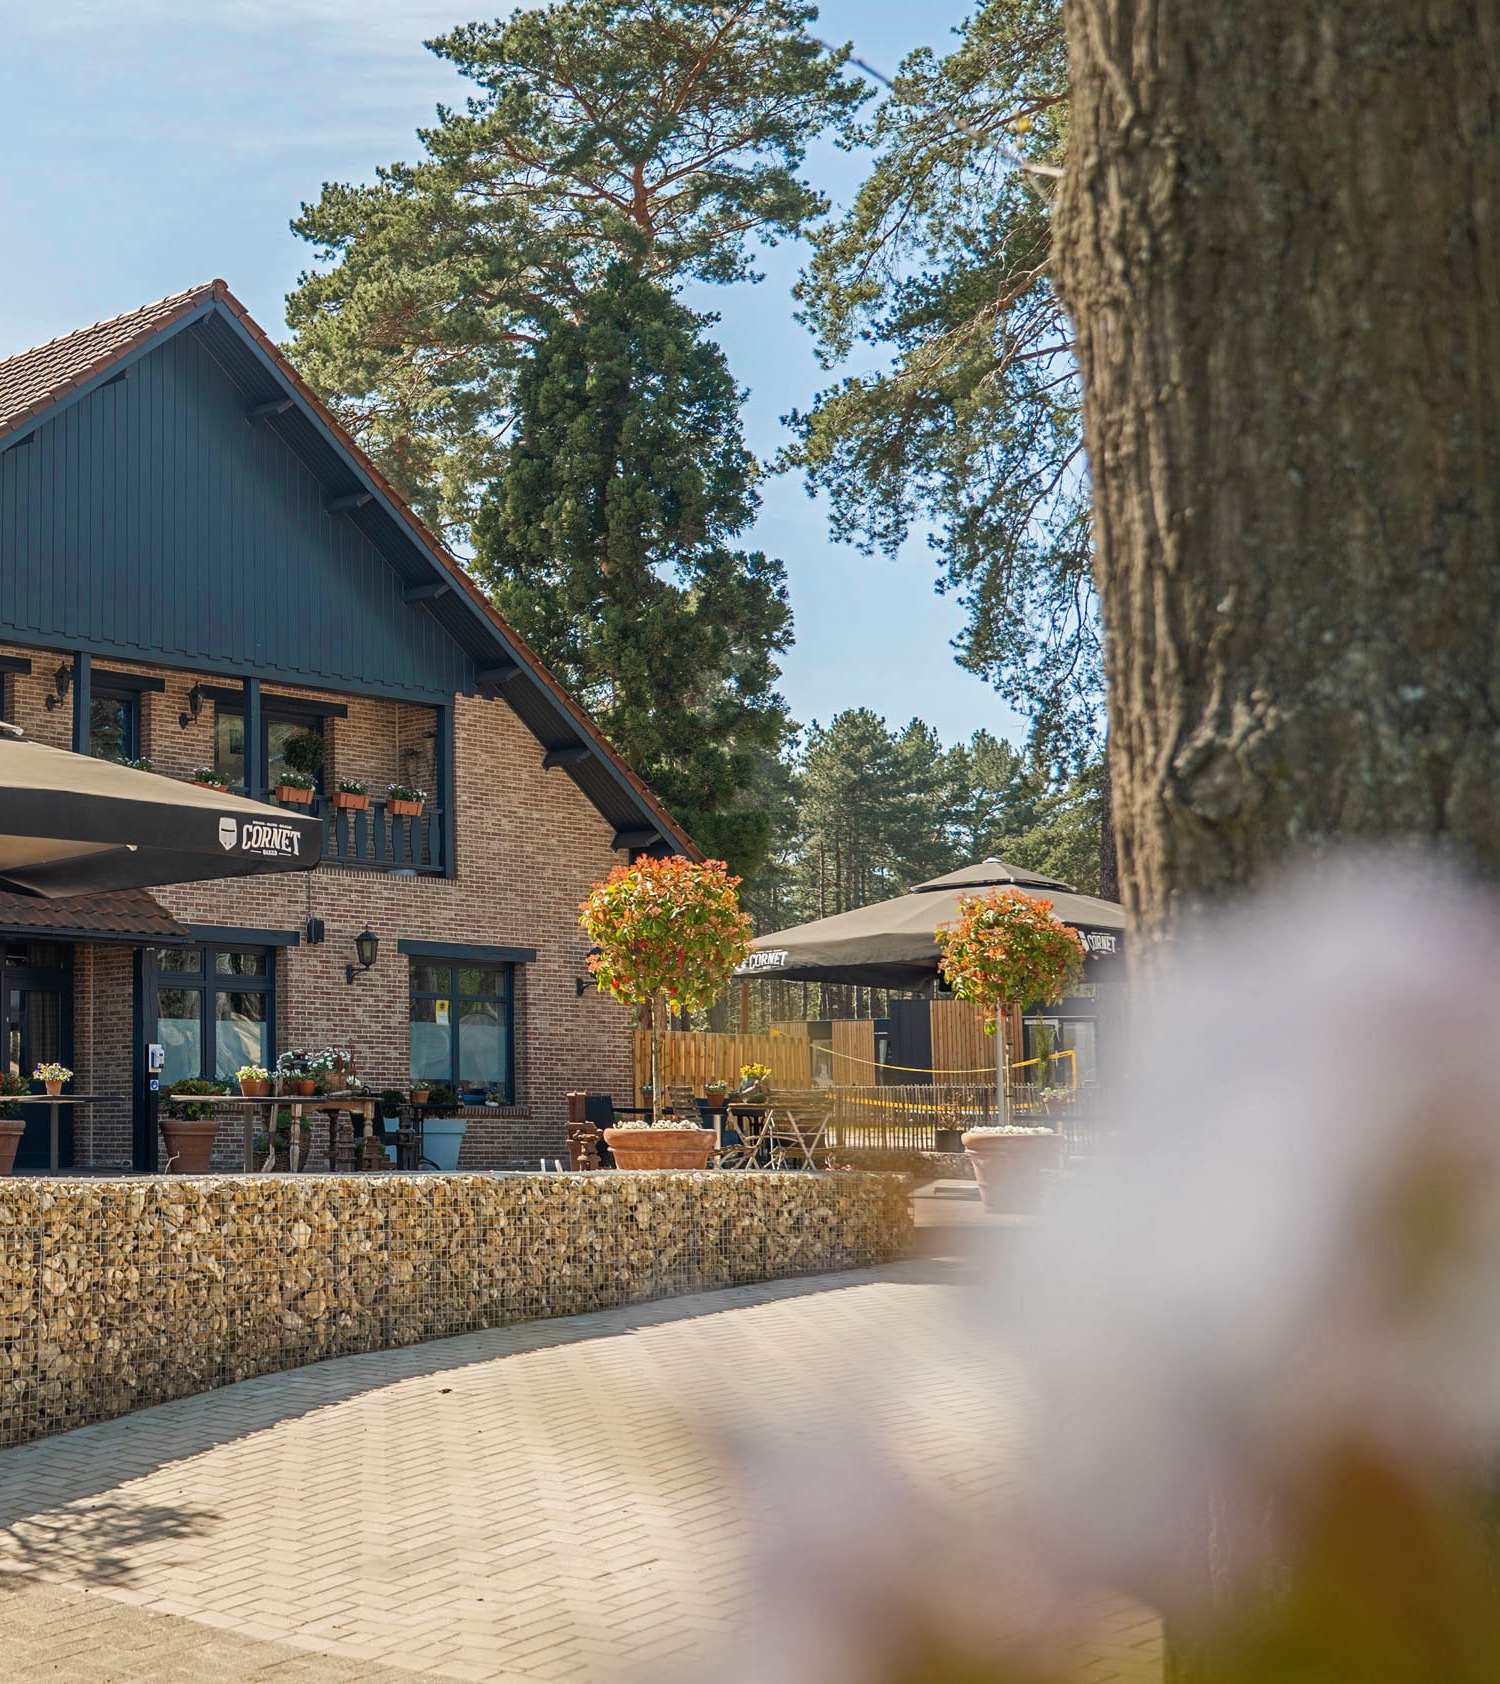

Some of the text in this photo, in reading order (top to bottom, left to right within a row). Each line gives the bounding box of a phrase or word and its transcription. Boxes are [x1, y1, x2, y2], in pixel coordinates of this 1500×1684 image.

[241, 824, 301, 856] CORNET
[1086, 934, 1116, 953] CORNET
[749, 951, 788, 970] CORNET
